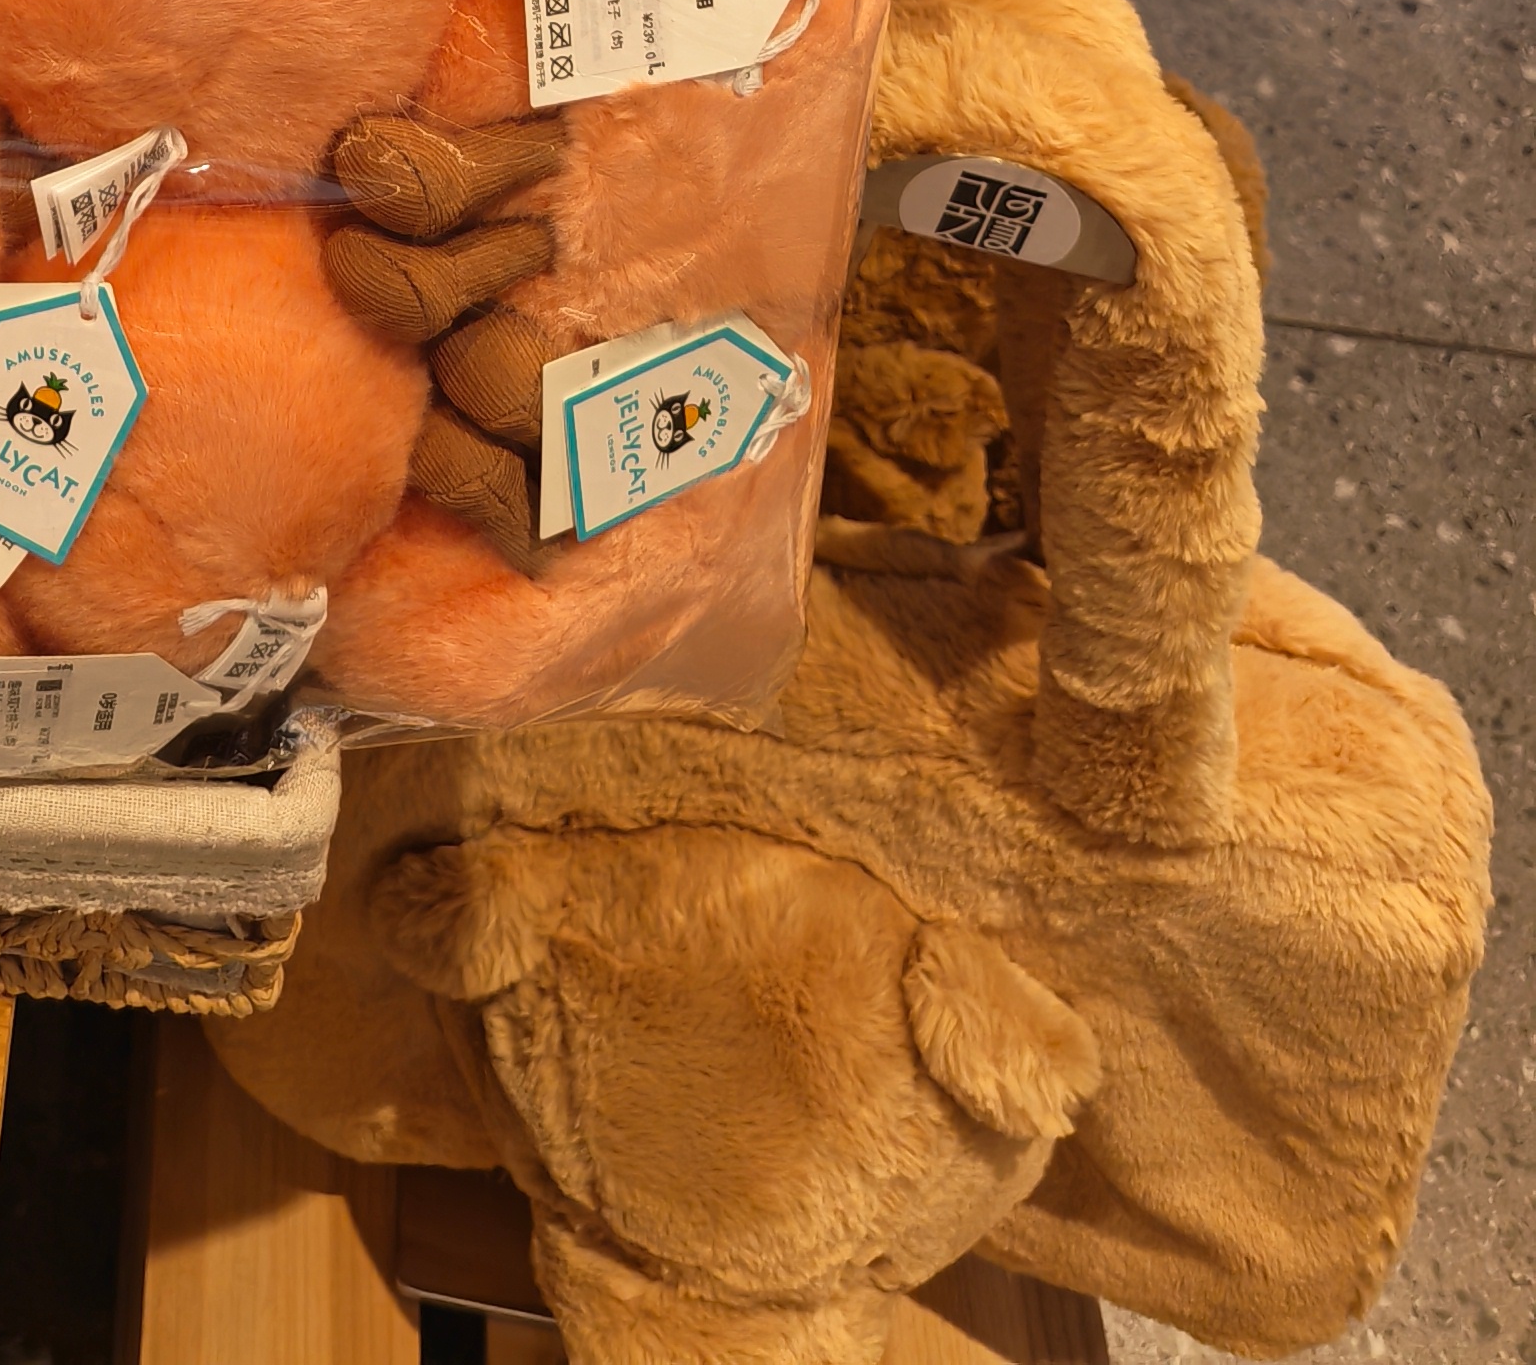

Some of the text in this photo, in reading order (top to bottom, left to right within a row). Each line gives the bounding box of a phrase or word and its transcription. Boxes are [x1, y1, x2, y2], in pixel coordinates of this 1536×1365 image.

[4, 346, 105, 418] AMUSEABLES
[692, 365, 731, 458] AMUSEABLES
[606, 433, 617, 473] LONDON
[613, 389, 647, 495] JELLYCAT
[93, 692, 118, 731] 0岁适用
